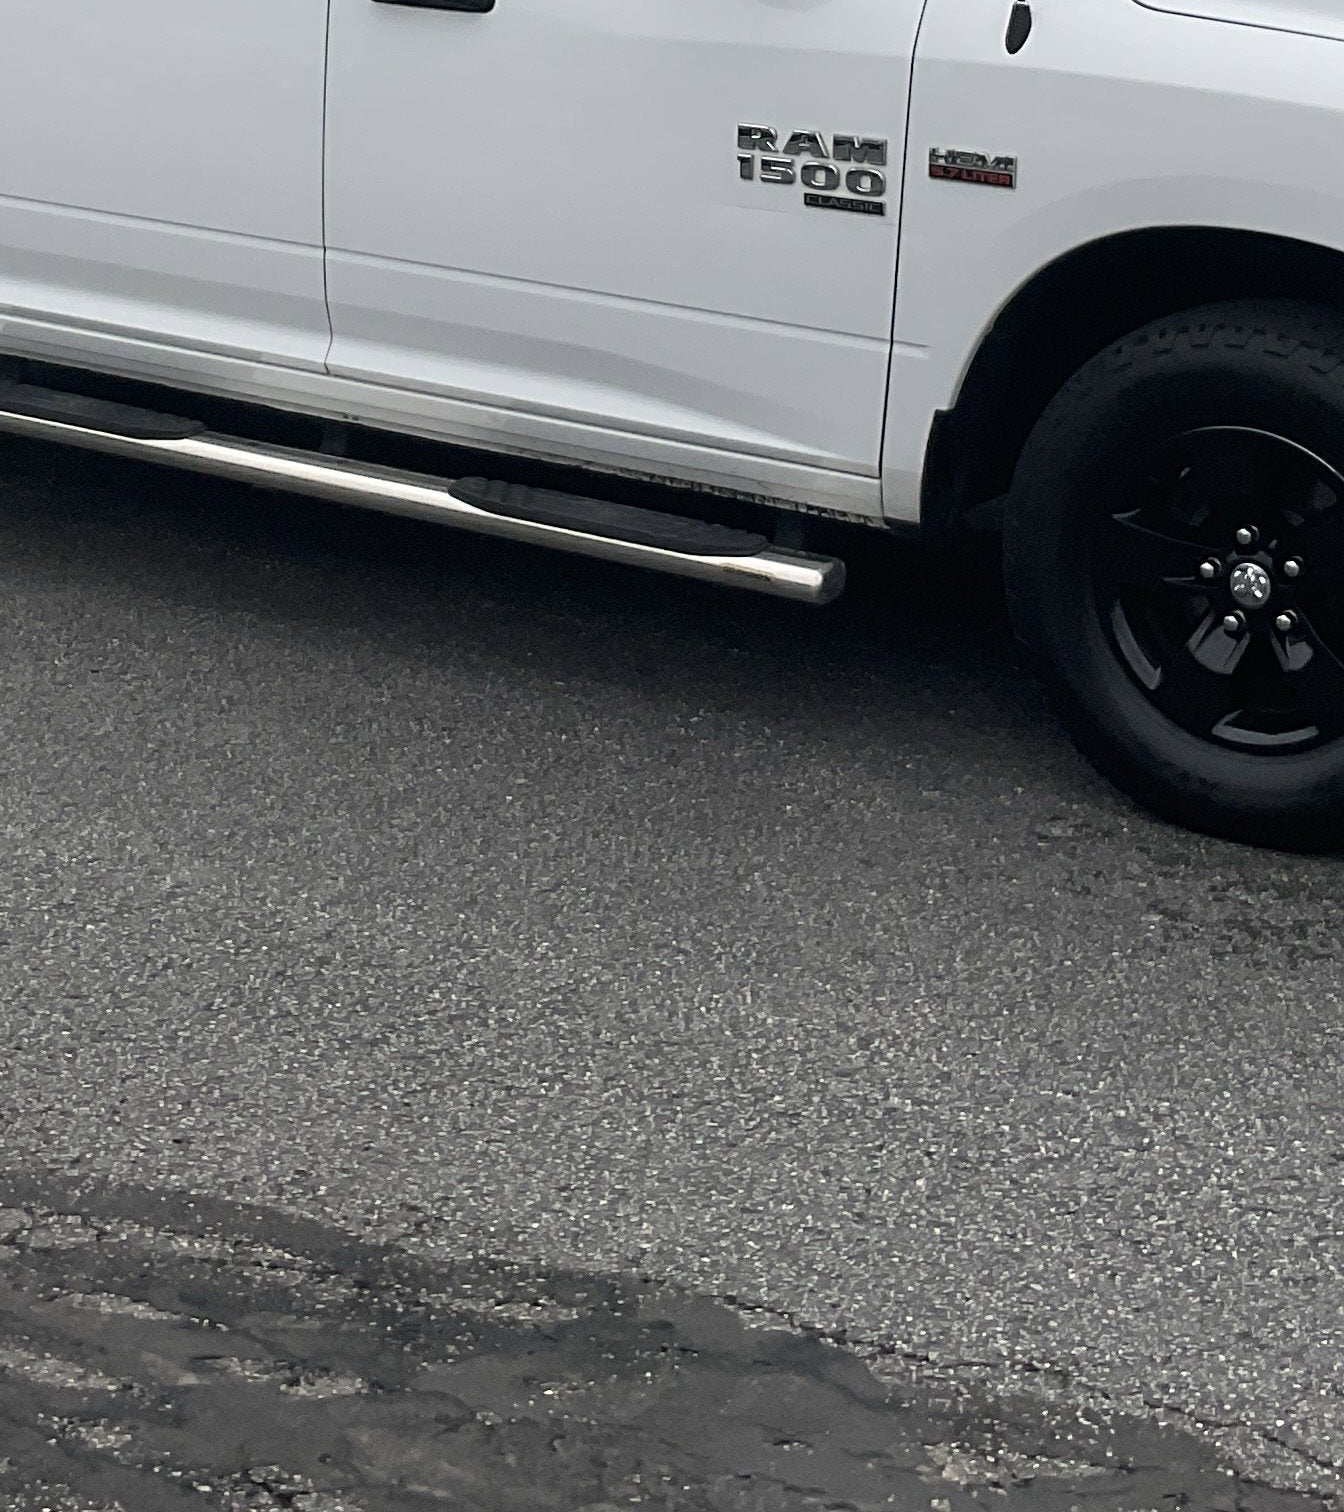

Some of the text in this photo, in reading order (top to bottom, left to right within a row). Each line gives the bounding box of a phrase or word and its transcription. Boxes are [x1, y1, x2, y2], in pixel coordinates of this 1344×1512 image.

[737, 122, 888, 166] RAM
[737, 152, 887, 197] 1500
[961, 168, 1011, 186] LITER
[805, 192, 884, 214] CLASSIC
